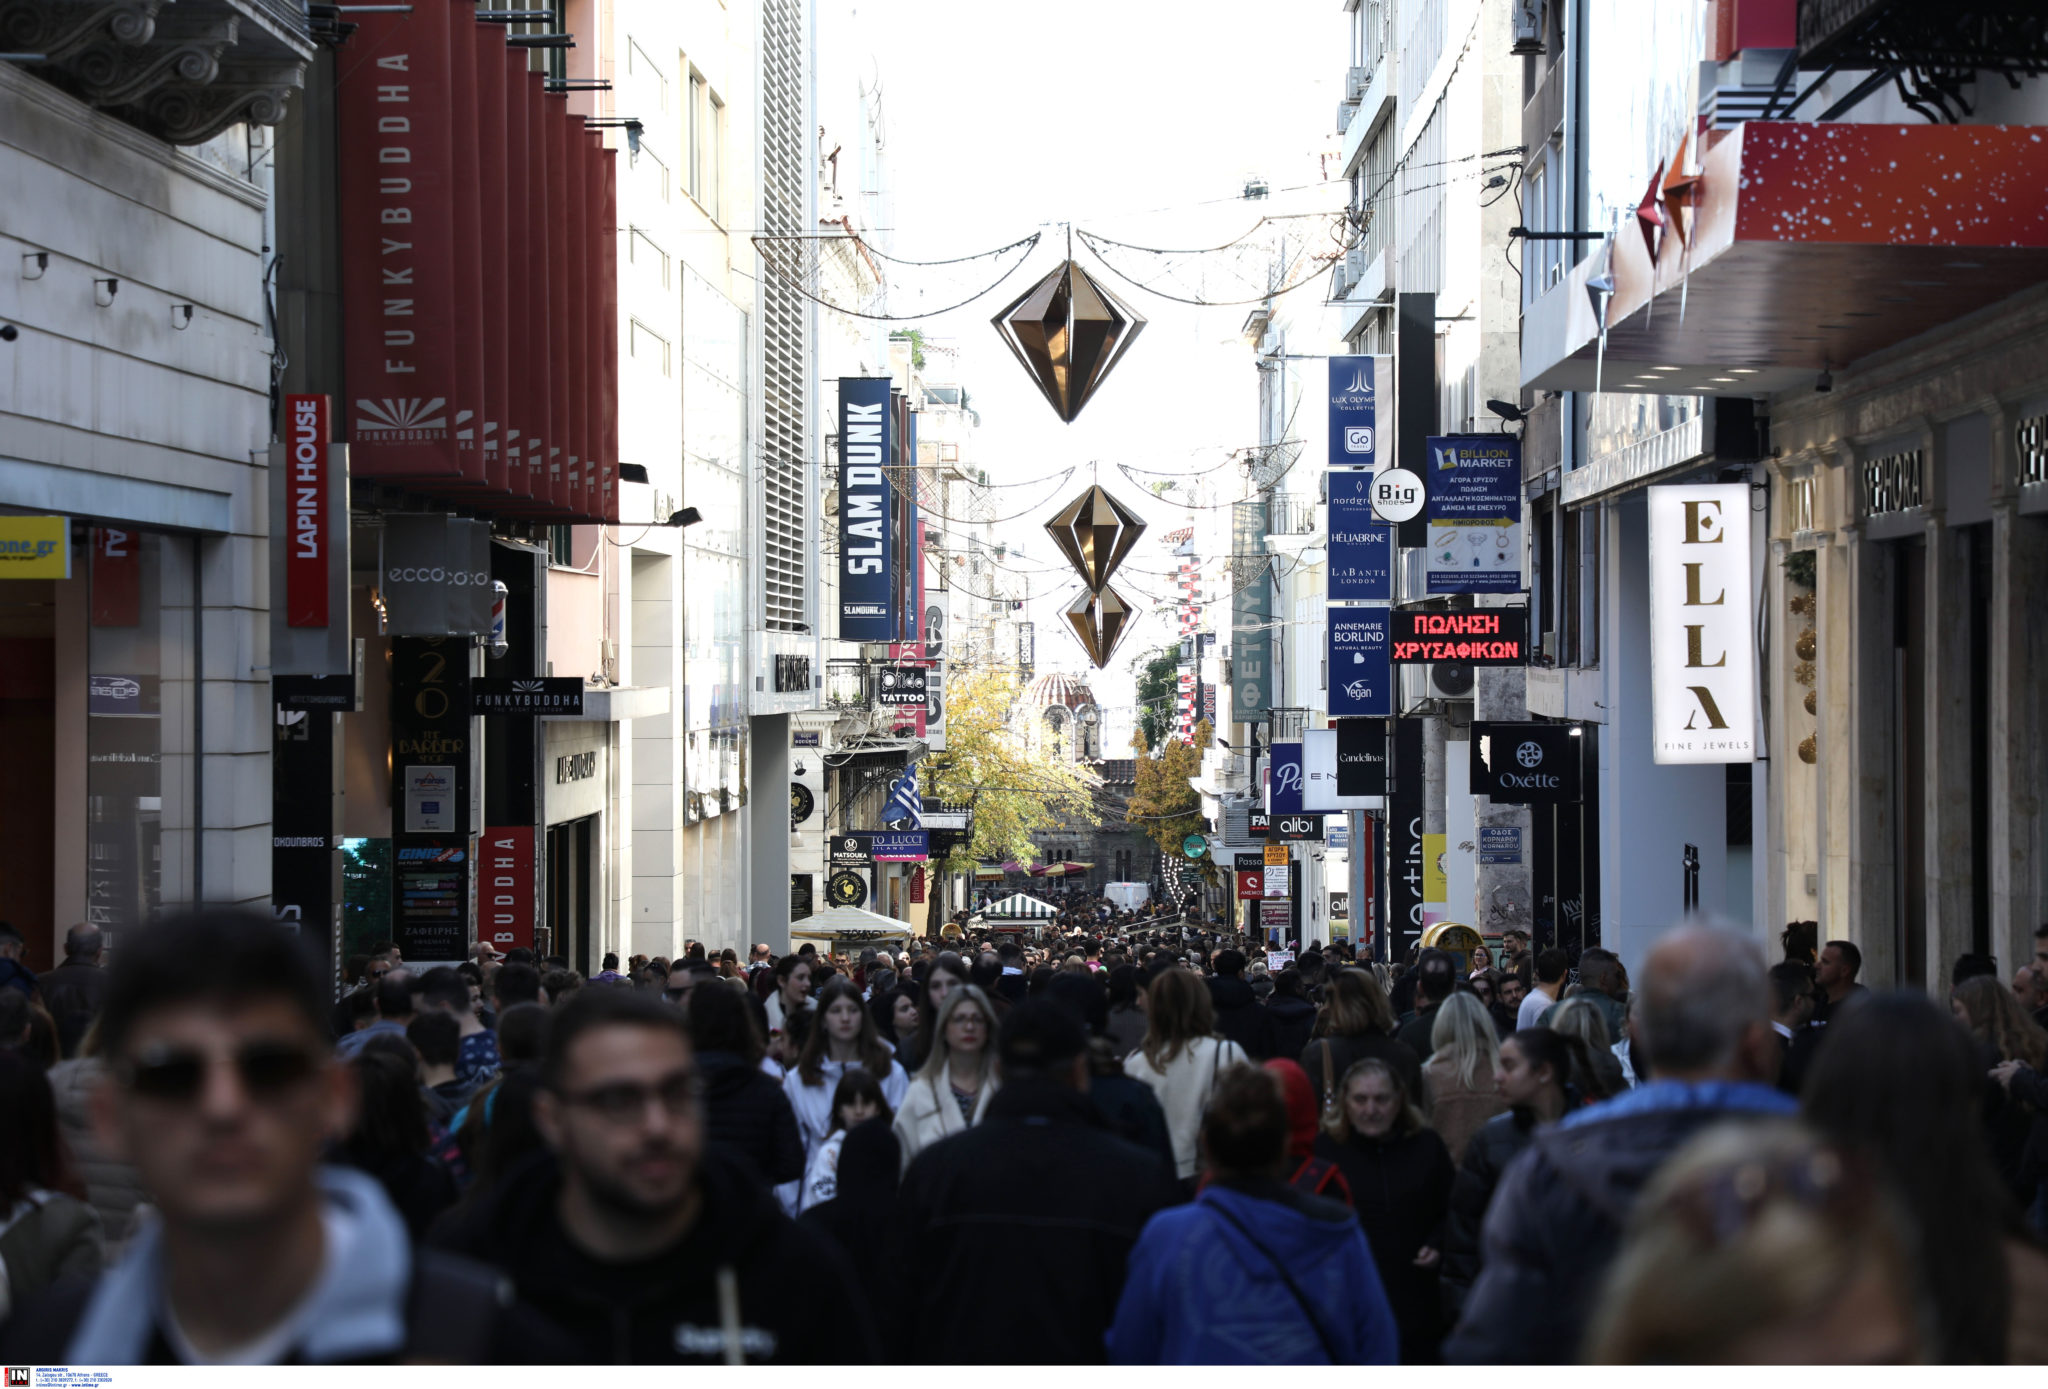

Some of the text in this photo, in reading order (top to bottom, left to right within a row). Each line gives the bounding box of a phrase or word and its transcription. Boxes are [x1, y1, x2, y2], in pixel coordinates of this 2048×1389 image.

[377, 54, 415, 373] FUNKYBUDDHA
[296, 401, 317, 481] HOUSE
[357, 431, 448, 440] FUNKYBUDDHA
[1350, 432, 1369, 444] Go
[847, 403, 882, 488] DUNK
[1460, 450, 1508, 458] BILLION
[1460, 459, 1512, 467] MARKET
[1863, 449, 1924, 516] SEPHORA
[1379, 485, 1415, 503] Big
[297, 488, 317, 558] LAPIN
[848, 495, 882, 574] SLAM
[389, 568, 445, 582] ecco
[1682, 501, 1730, 730] ELLA
[1414, 615, 1499, 634] ΠΩΛΗΣΗ
[1394, 642, 1518, 659] ΧΡΥΣΑΦΙΚΩΝ
[1341, 680, 1372, 700] Vegan
[476, 695, 580, 706] FUNKYBUDDHA
[882, 694, 925, 702] TATTOO
[1665, 741, 1749, 750] FINE JEWELS
[1500, 773, 1560, 788] Oxétte
[1280, 817, 1313, 833] alibi
[273, 837, 325, 847] OKOUNBROS
[892, 835, 922, 844] LUCCI
[1331, 897, 1348, 911] ali
[405, 927, 460, 935] ΖΑΦΕΙΡΗΣ
